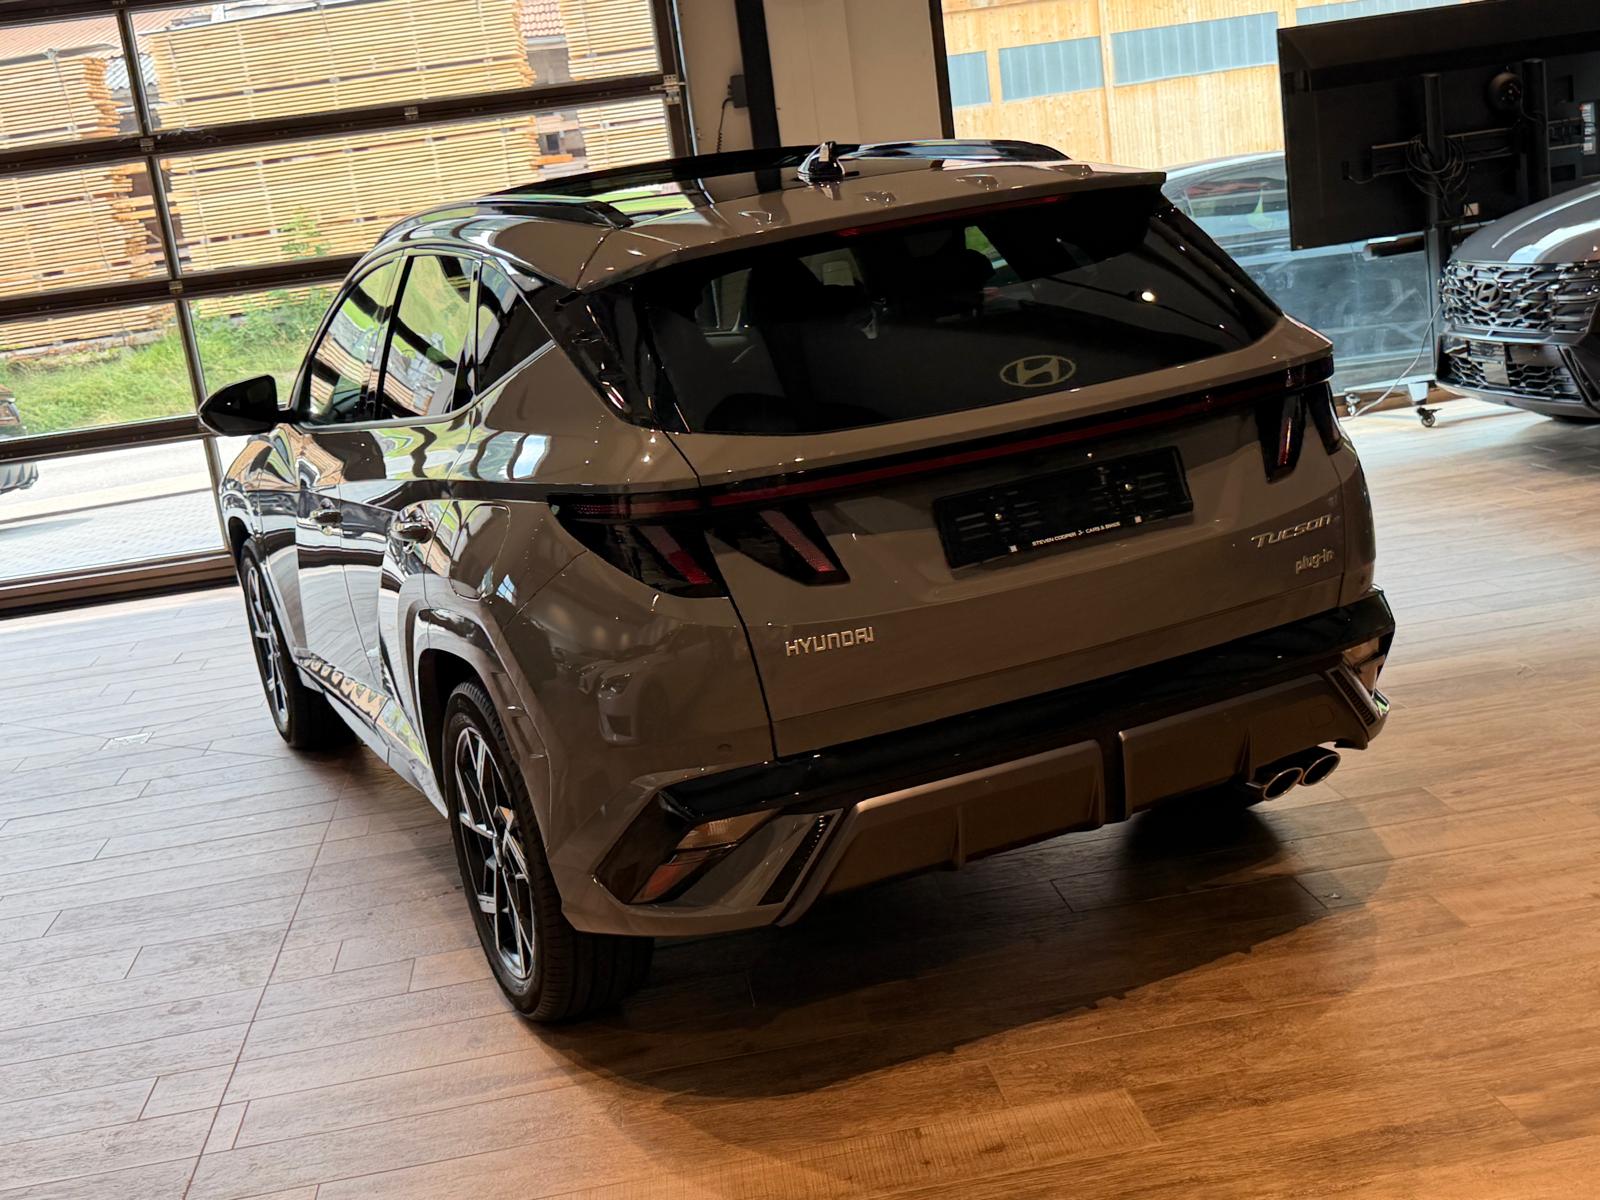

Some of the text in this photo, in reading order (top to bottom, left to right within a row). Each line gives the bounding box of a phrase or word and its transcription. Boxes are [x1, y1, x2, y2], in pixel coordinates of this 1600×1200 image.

[1032, 537, 1054, 546] STEVEN
[1054, 532, 1076, 541] COOPER
[1296, 548, 1334, 574] plug-in
[785, 626, 875, 657] HYUNDAI
